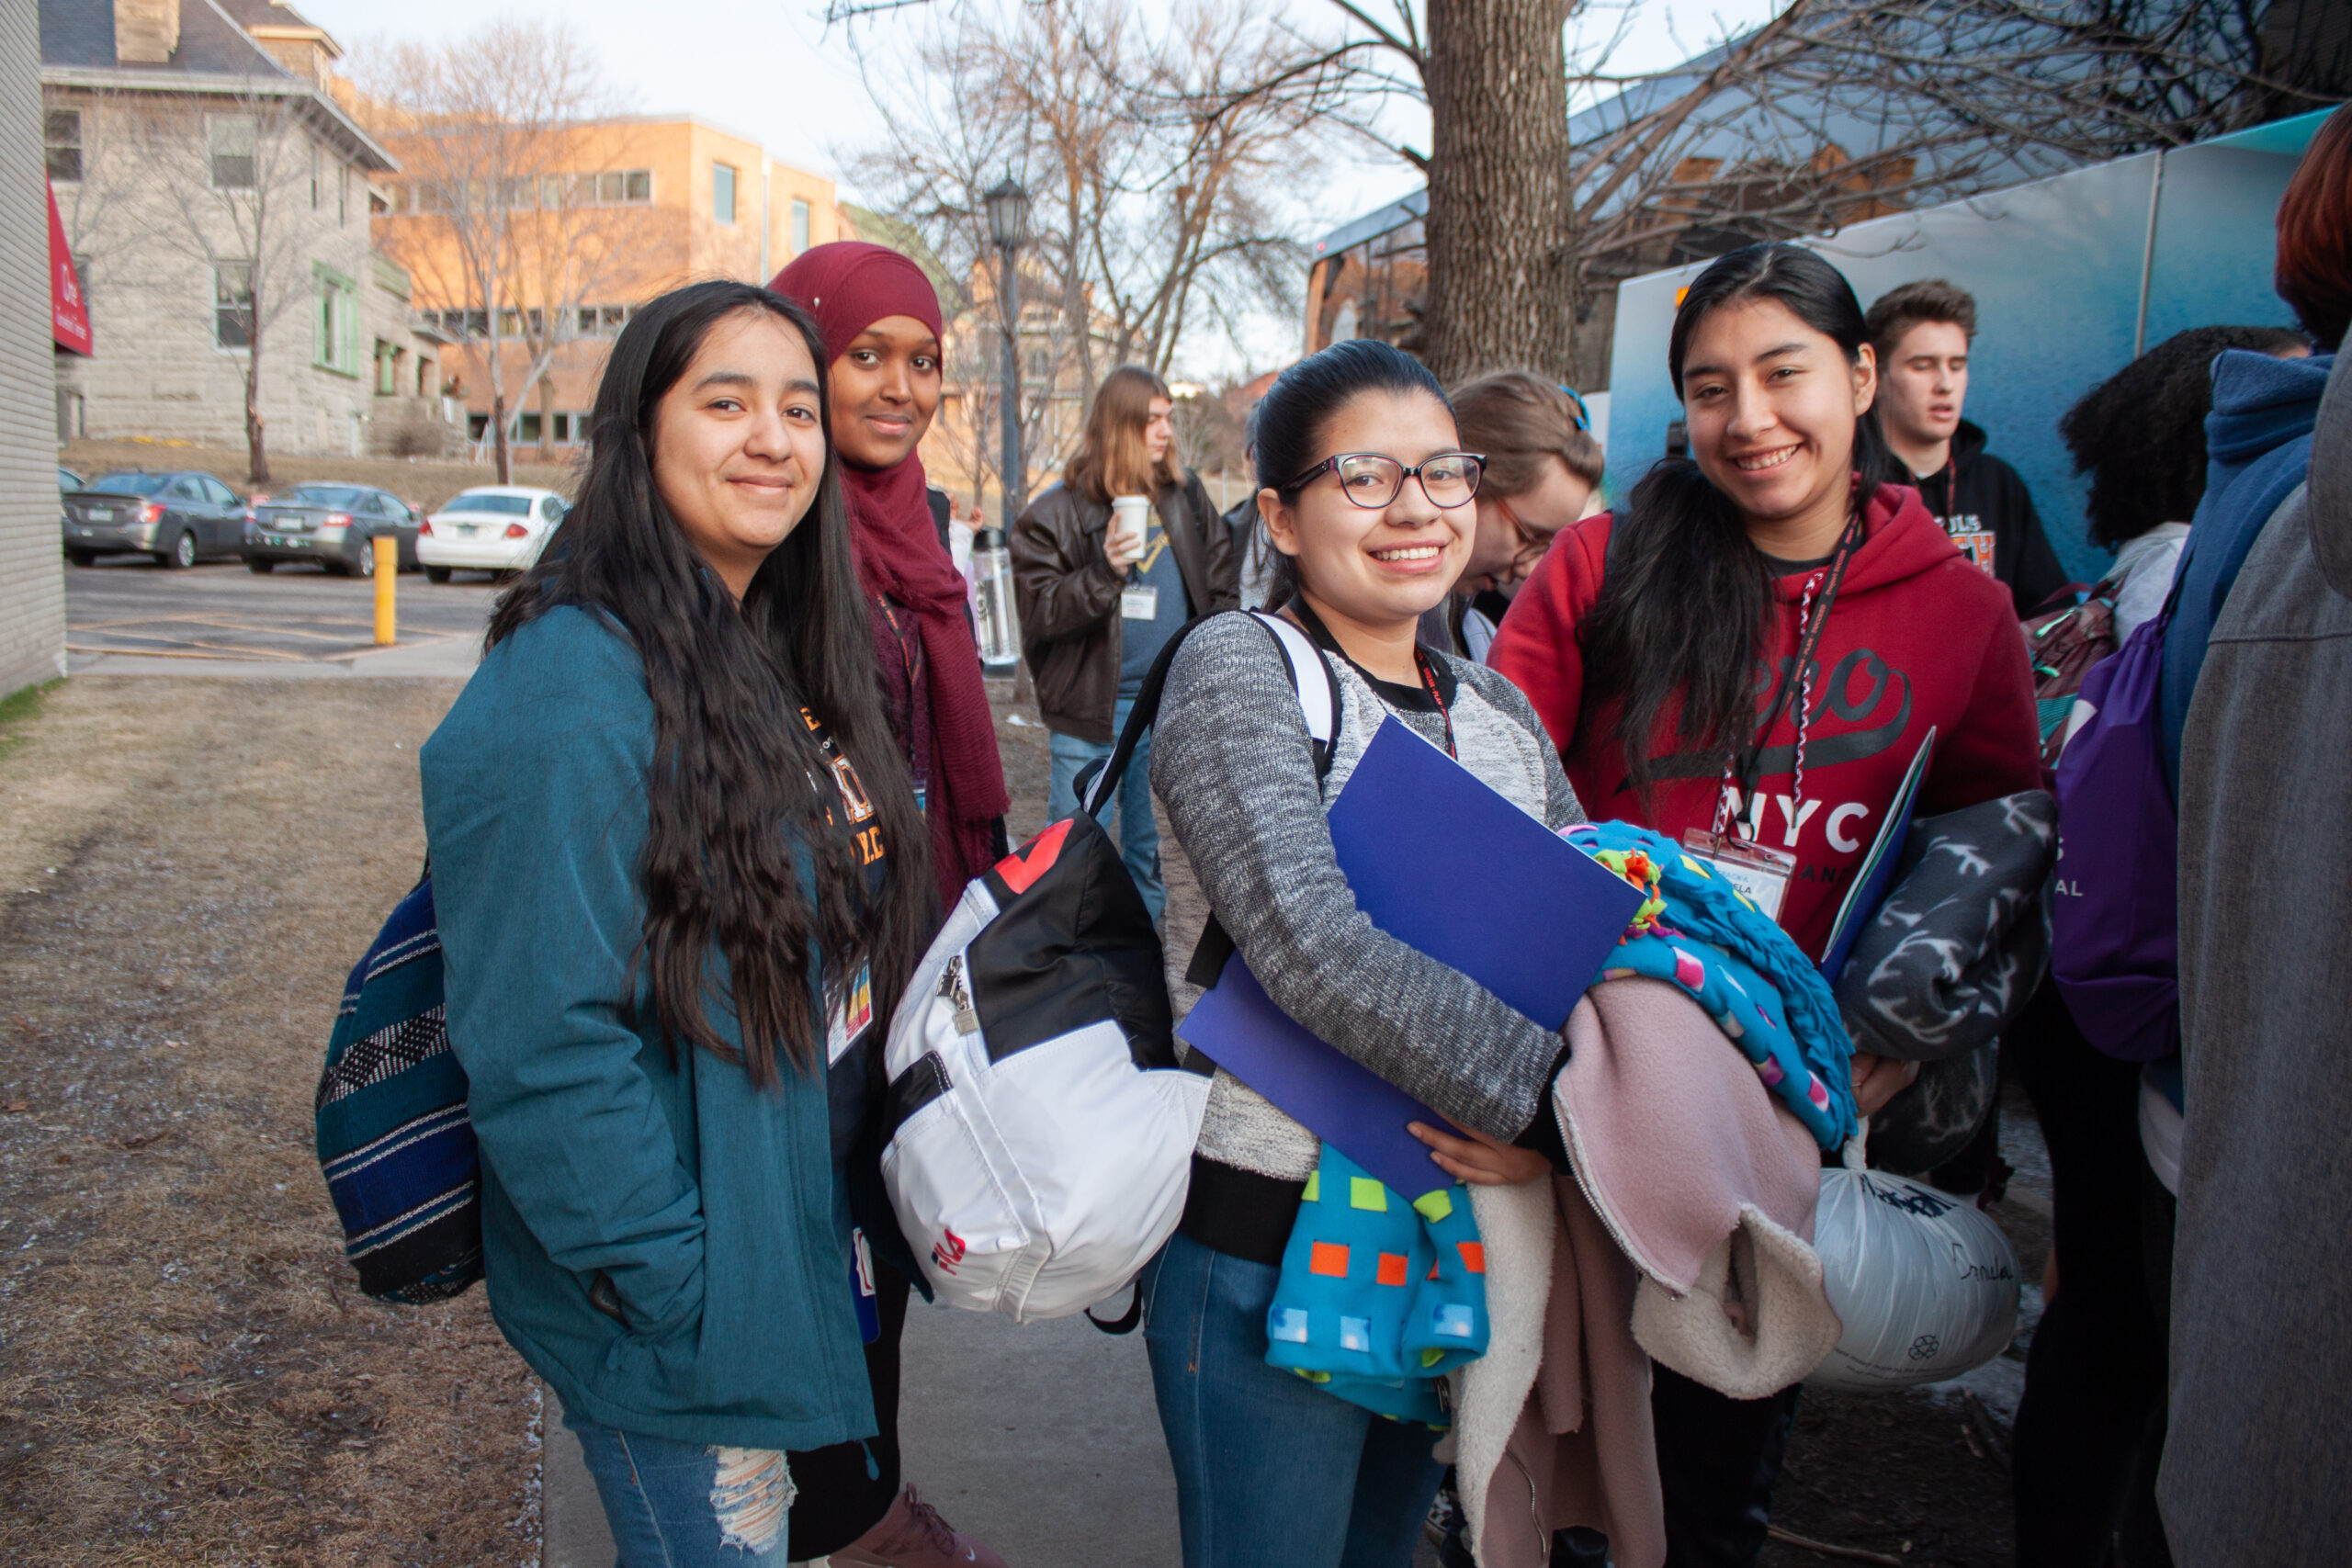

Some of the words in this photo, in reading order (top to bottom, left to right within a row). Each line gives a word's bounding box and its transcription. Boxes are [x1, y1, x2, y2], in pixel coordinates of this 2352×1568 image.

[1712, 786, 1870, 853] NYC
[2054, 879, 2084, 897] AL
[931, 1227, 967, 1276] FILA
